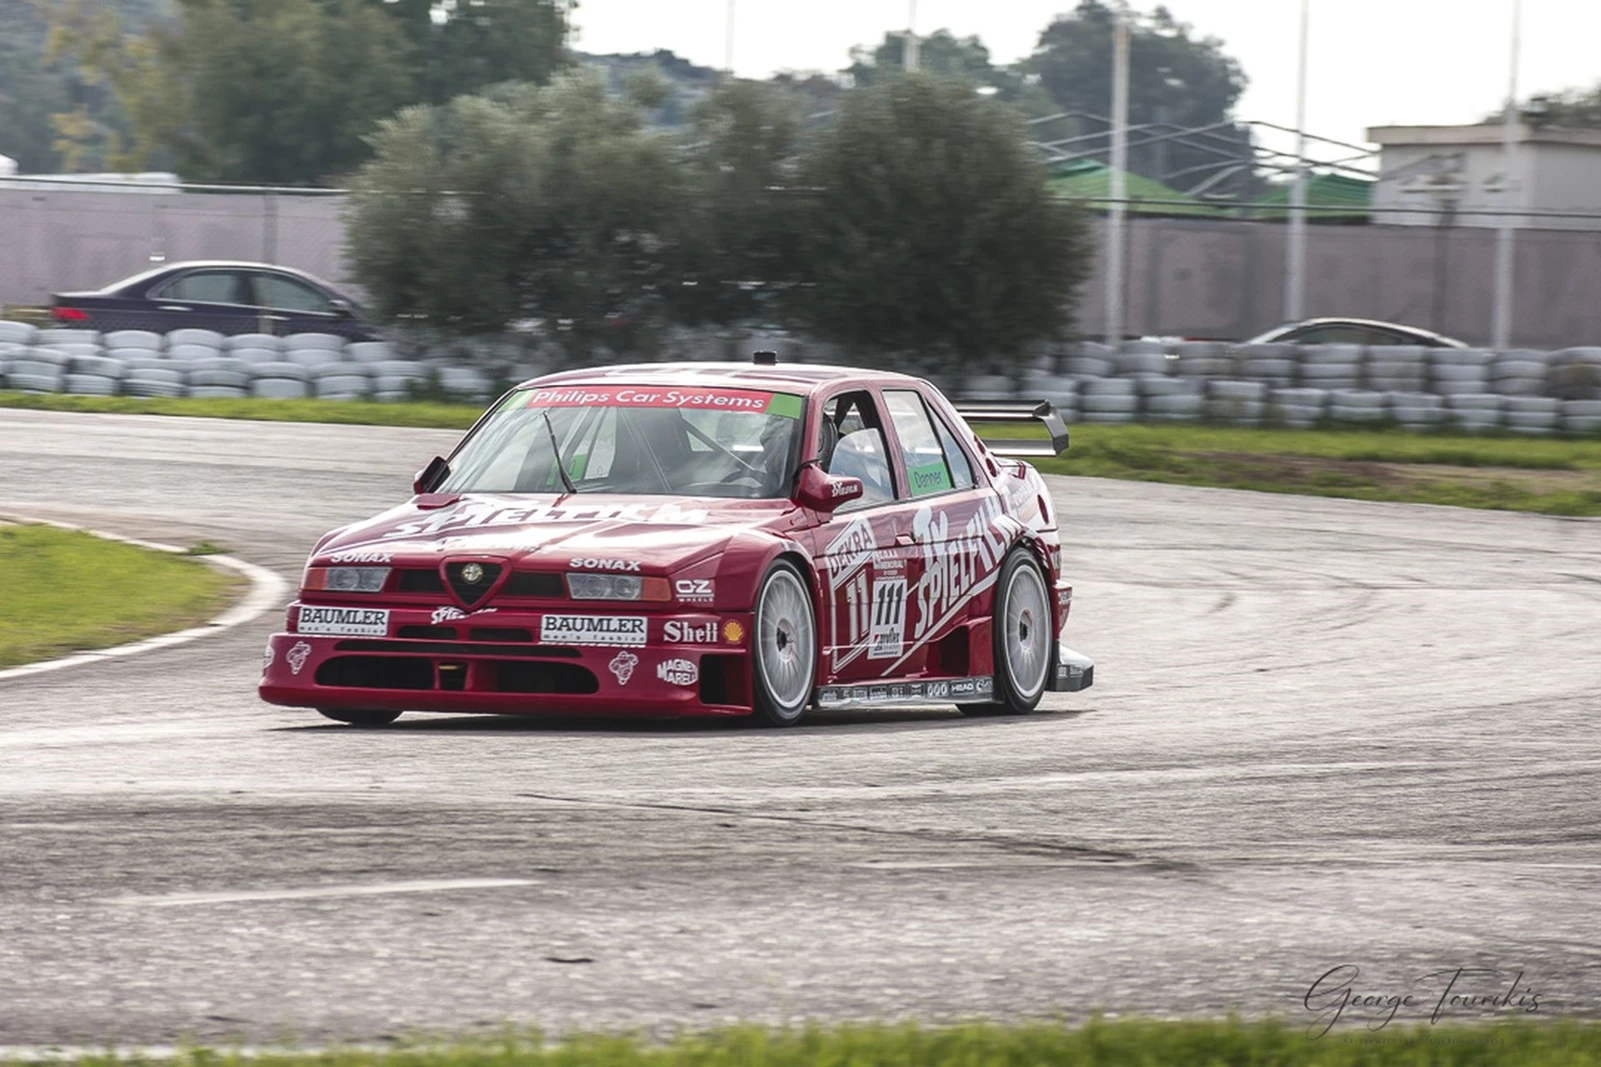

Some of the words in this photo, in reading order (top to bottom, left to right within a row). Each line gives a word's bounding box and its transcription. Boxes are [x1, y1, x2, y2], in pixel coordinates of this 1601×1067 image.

[532, 390, 609, 405] Philips
[616, 390, 660, 403] Car
[663, 391, 764, 408] Systems
[330, 552, 391, 563] SONAX
[829, 523, 873, 579] DEKRA
[569, 557, 641, 571] SONAX
[676, 580, 712, 594] OZ
[875, 582, 904, 626] 111
[663, 621, 718, 642] Shell
